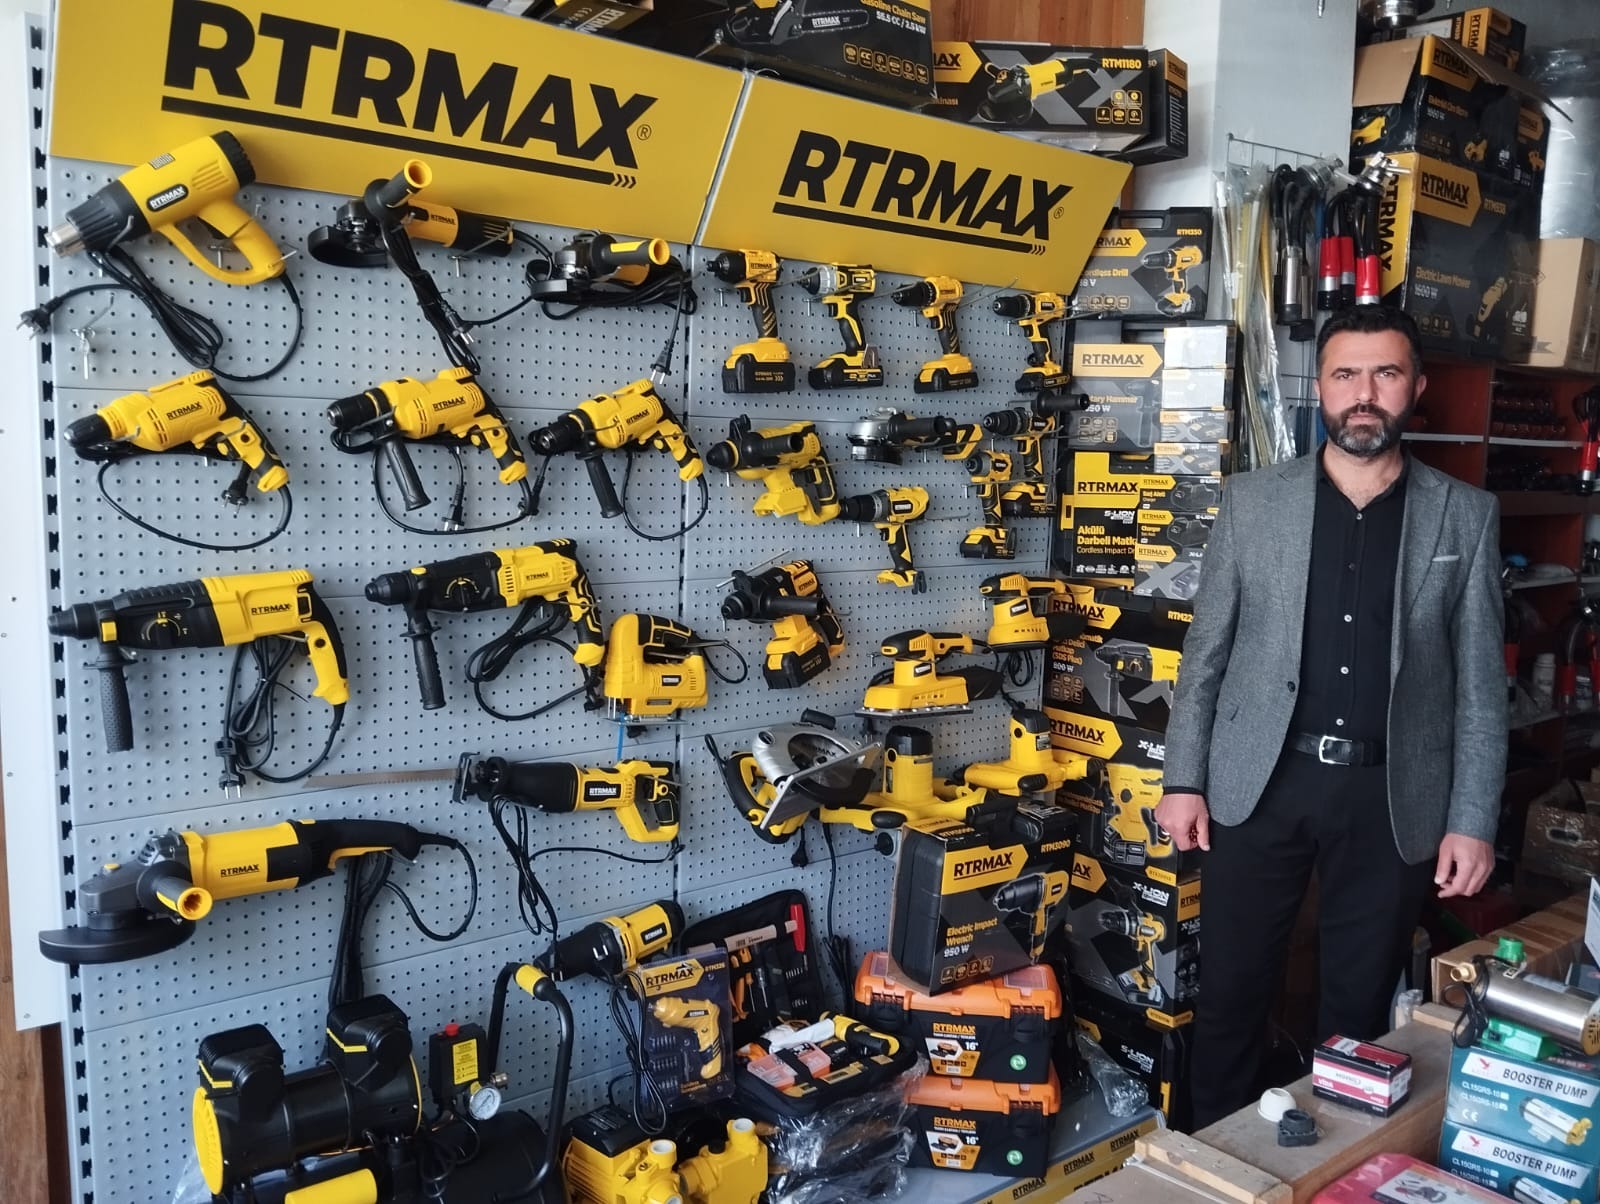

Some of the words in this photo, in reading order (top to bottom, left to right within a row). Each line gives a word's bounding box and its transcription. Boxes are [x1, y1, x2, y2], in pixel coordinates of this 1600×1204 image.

[892, 5, 911, 18] Chain
[812, 16, 841, 28] RTRMAX
[1102, 58, 1142, 69] RTM1180
[164, 0, 658, 169] RTRMAX
[778, 130, 1074, 241] RTRMAX
[1421, 172, 1469, 205] RTRMAX
[150, 185, 186, 209] RTRMAX
[1094, 236, 1132, 247] RMAX
[1112, 268, 1129, 277] Drill
[1082, 354, 1145, 365] RTRMAX
[432, 396, 466, 411] RTRMAX
[166, 402, 202, 420] RTRMAX
[1078, 482, 1138, 493] RTRMAX
[1078, 526, 1105, 535] Akülü
[1077, 536, 1111, 545] Darbeli
[1077, 546, 1104, 554] Cordless
[1105, 547, 1127, 555] Impact
[1139, 548, 1168, 556] RTRMAX
[251, 603, 292, 615] RTRMAX
[1168, 611, 1193, 623] RTM22
[1050, 720, 1106, 743] RTRMAX
[589, 787, 617, 796] RTRMAX
[1041, 840, 1071, 853] RTM3090
[220, 864, 260, 877] RTRMAX
[954, 852, 1013, 877] RTRMAX
[1180, 892, 1200, 908] RTRM
[947, 924, 974, 937] Electric
[974, 918, 998, 932] Impact
[946, 935, 974, 947] Wrench
[944, 946, 960, 957] 950
[961, 944, 970, 954] W
[646, 968, 694, 987] RTRMAX
[933, 1023, 976, 1034] RTRMAX
[1503, 1068, 1553, 1090] BOOSTER
[1555, 1083, 1588, 1099] PUMP
[934, 1117, 976, 1129] RTRMAX
[1110, 1130, 1140, 1150] RTRMAX
[1063, 1152, 1095, 1174] RTRMAX
[1493, 1146, 1543, 1170] BOOSTER
[1544, 1162, 1577, 1180] PUMP
[1012, 1177, 1046, 1199] RTRMAX
